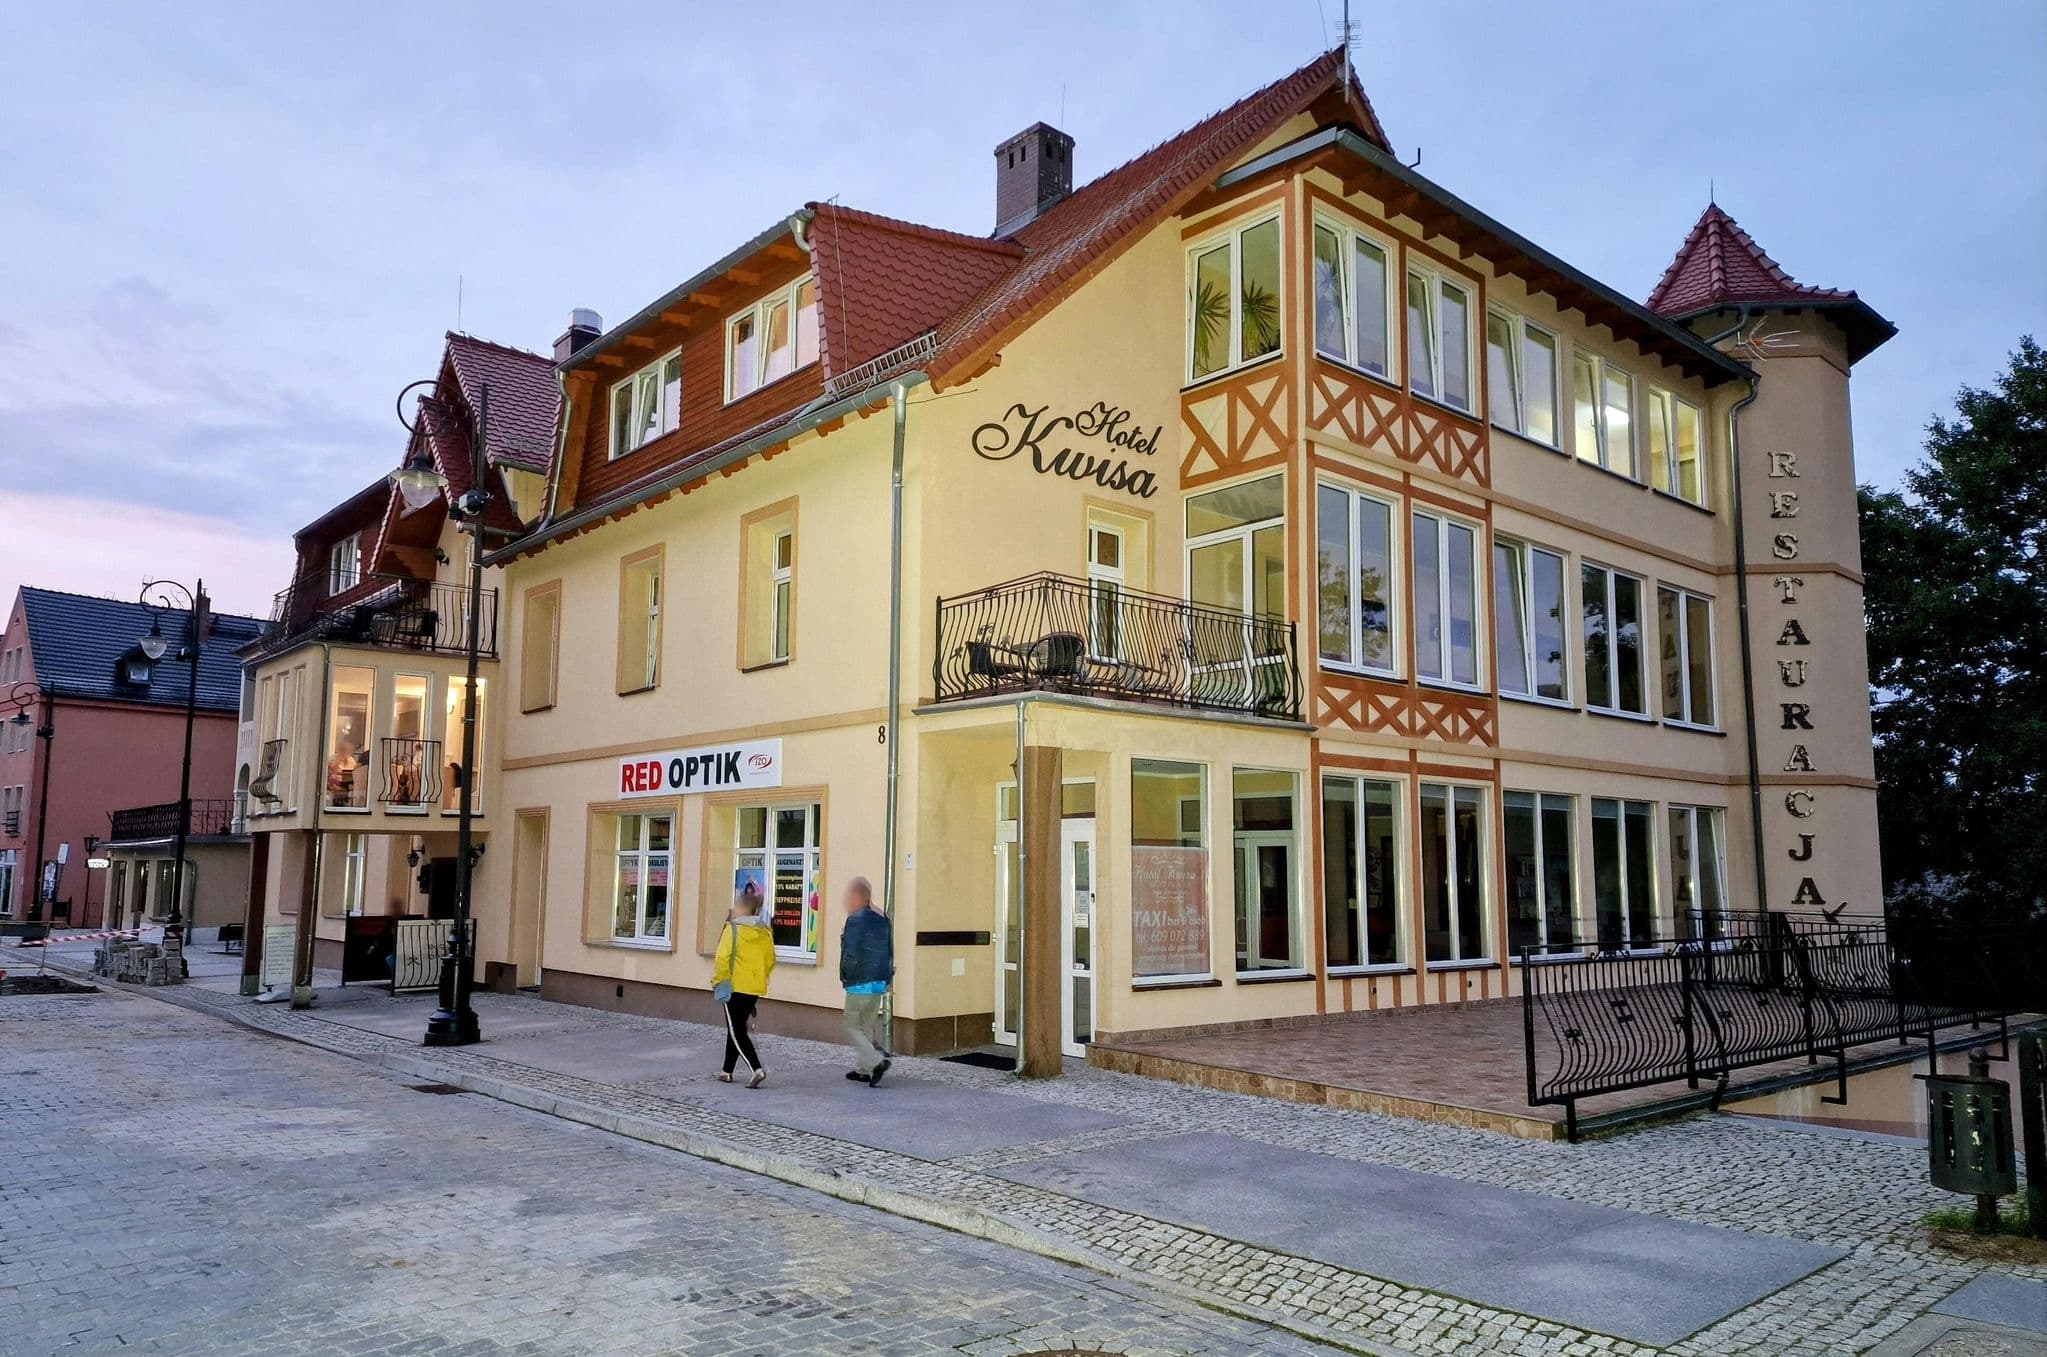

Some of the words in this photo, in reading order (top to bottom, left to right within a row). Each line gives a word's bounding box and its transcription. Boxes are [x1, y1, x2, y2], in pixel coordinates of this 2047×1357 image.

[1075, 401, 1163, 456] Hotel
[971, 403, 1159, 499] Kwisa
[1767, 449, 1827, 905] RESTAURACJA
[877, 725, 886, 744] 8
[621, 760, 663, 793] RED
[668, 750, 742, 788] OPTIK
[741, 856, 763, 867] OPTIK
[1134, 910, 1167, 928] TAXI
